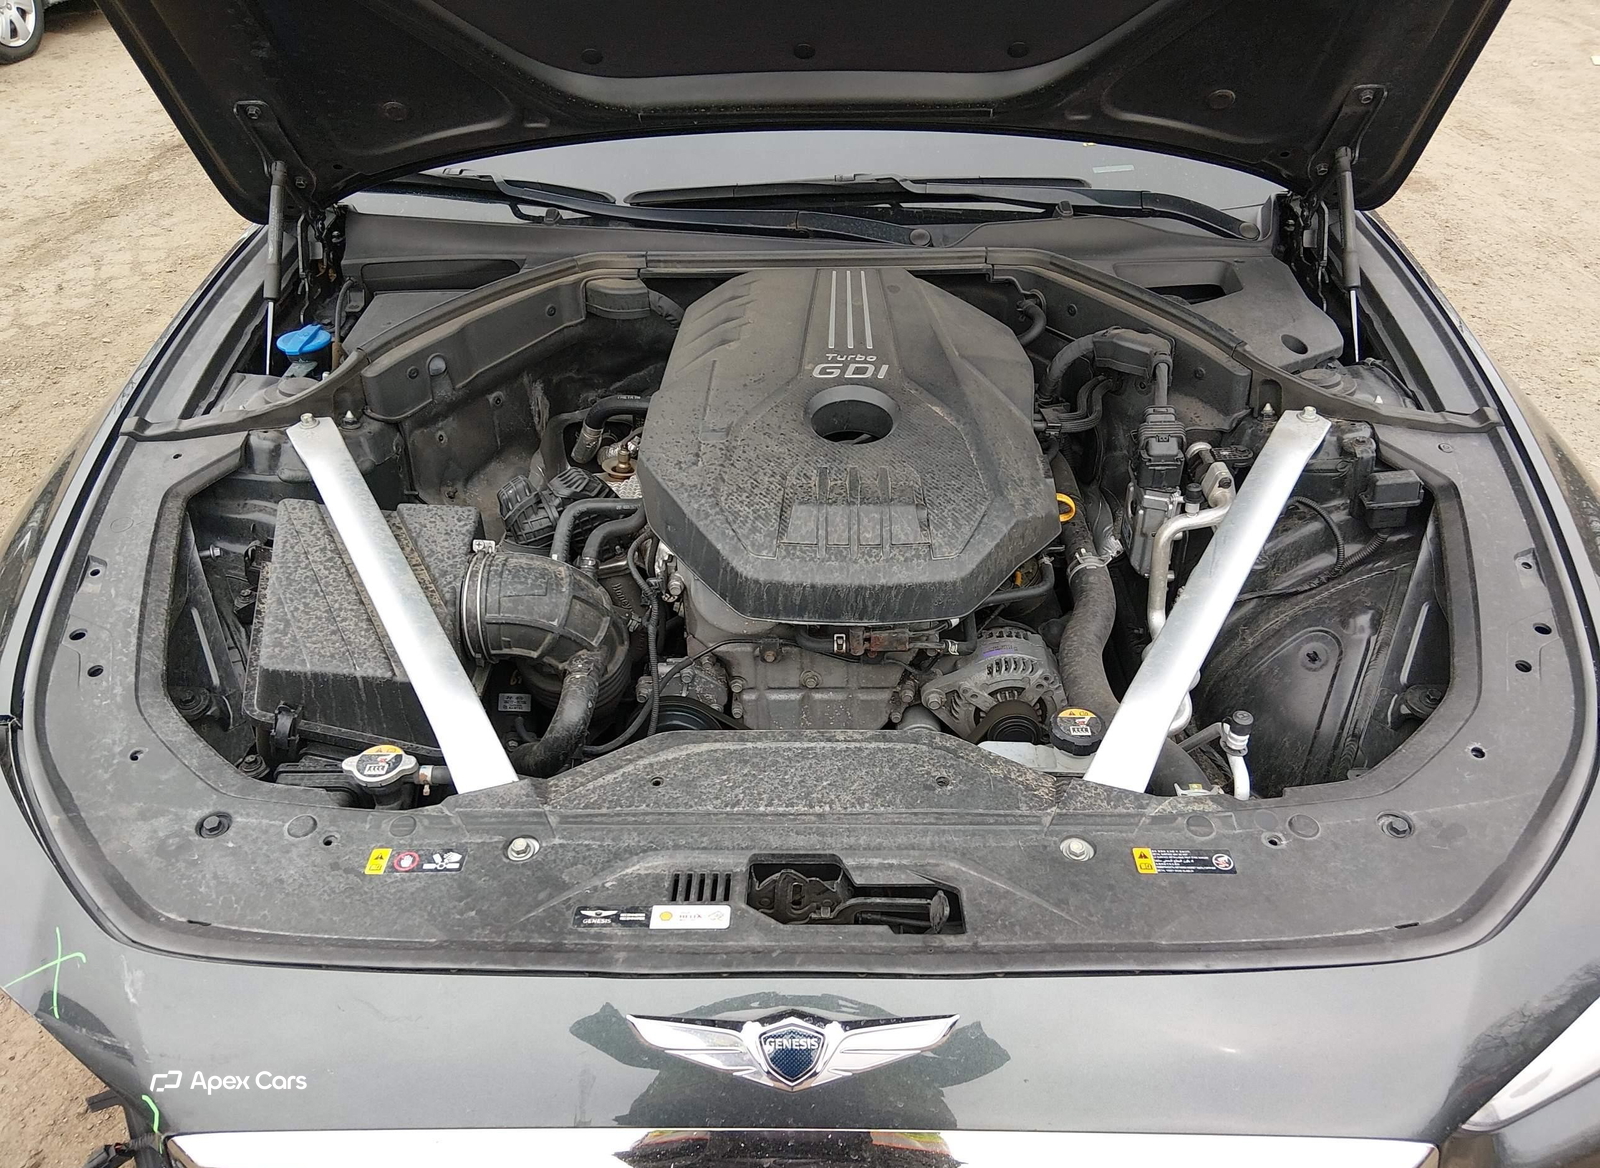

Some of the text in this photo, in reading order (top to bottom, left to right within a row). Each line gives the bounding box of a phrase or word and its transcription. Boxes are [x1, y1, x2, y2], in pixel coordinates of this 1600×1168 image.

[825, 353, 877, 362] Turbo
[812, 363, 889, 379] GDI
[765, 1038, 819, 1050] GENESIS
